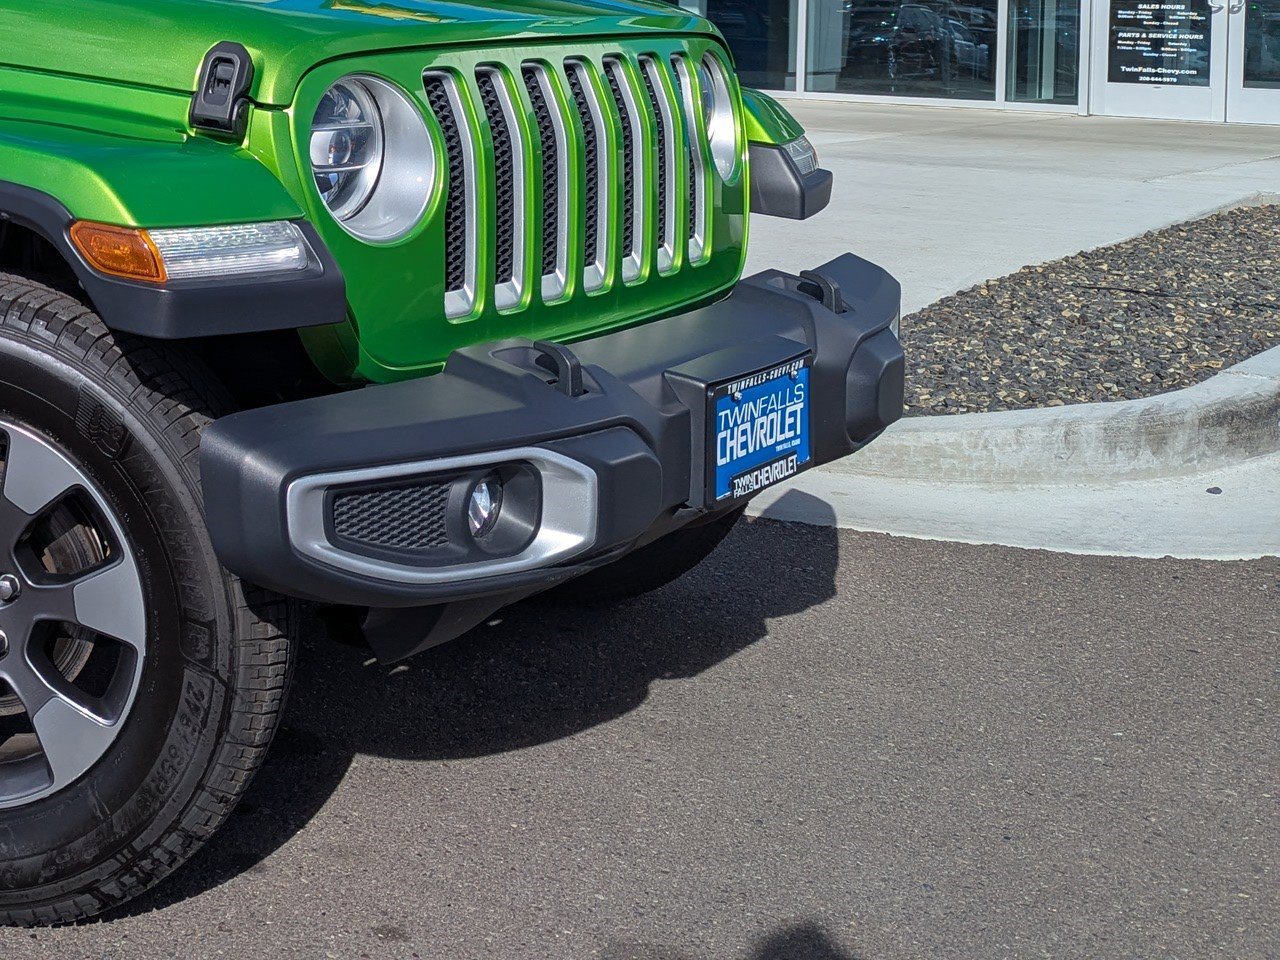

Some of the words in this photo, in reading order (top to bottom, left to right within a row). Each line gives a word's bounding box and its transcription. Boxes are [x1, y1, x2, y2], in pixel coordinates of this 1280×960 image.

[1120, 66, 1197, 75] TwinFalls-Chevy.com
[718, 383, 804, 431] TWINFALLS
[717, 402, 804, 466] CHEVROLET
[734, 472, 754, 491] TWIN
[753, 454, 797, 490] CHEVROLET
[734, 482, 754, 499] FALLS
